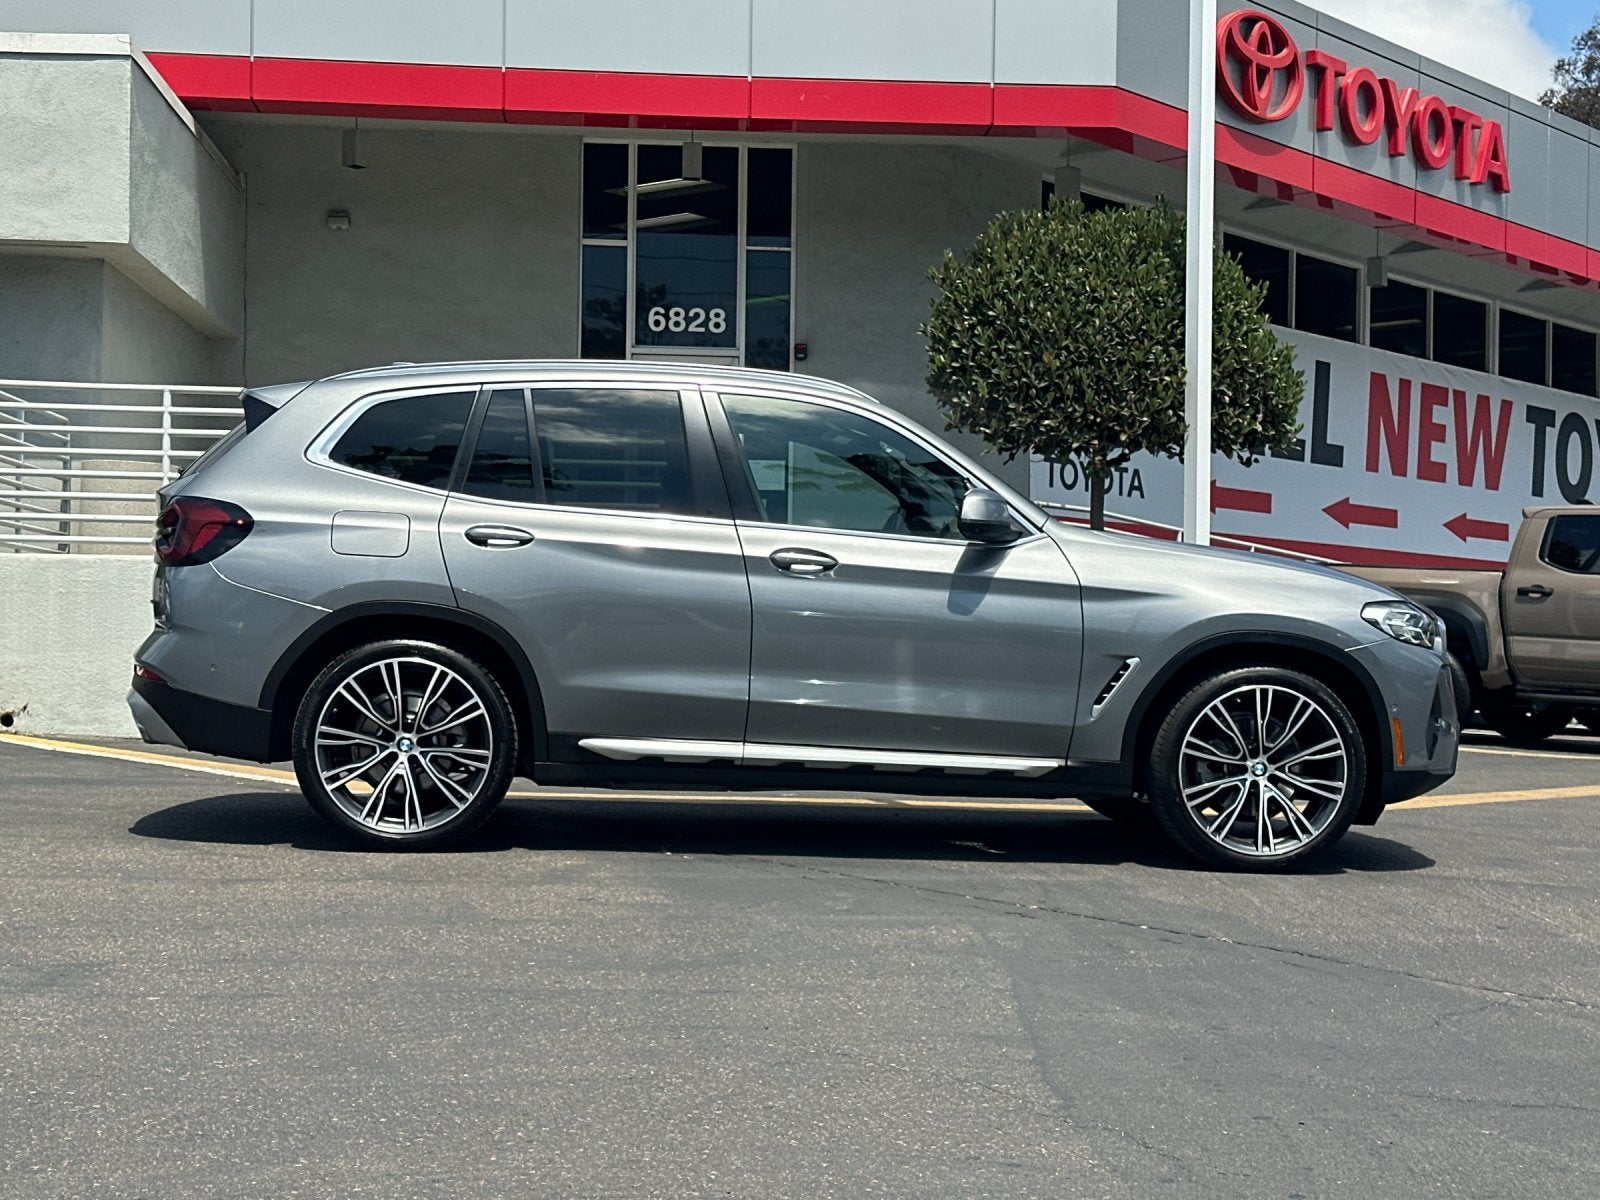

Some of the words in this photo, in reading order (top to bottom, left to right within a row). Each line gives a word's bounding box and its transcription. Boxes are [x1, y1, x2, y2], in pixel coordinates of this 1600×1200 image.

[1306, 50, 1510, 193] TOYOTA
[648, 307, 726, 333] 6828
[1366, 371, 1513, 491] NEW
